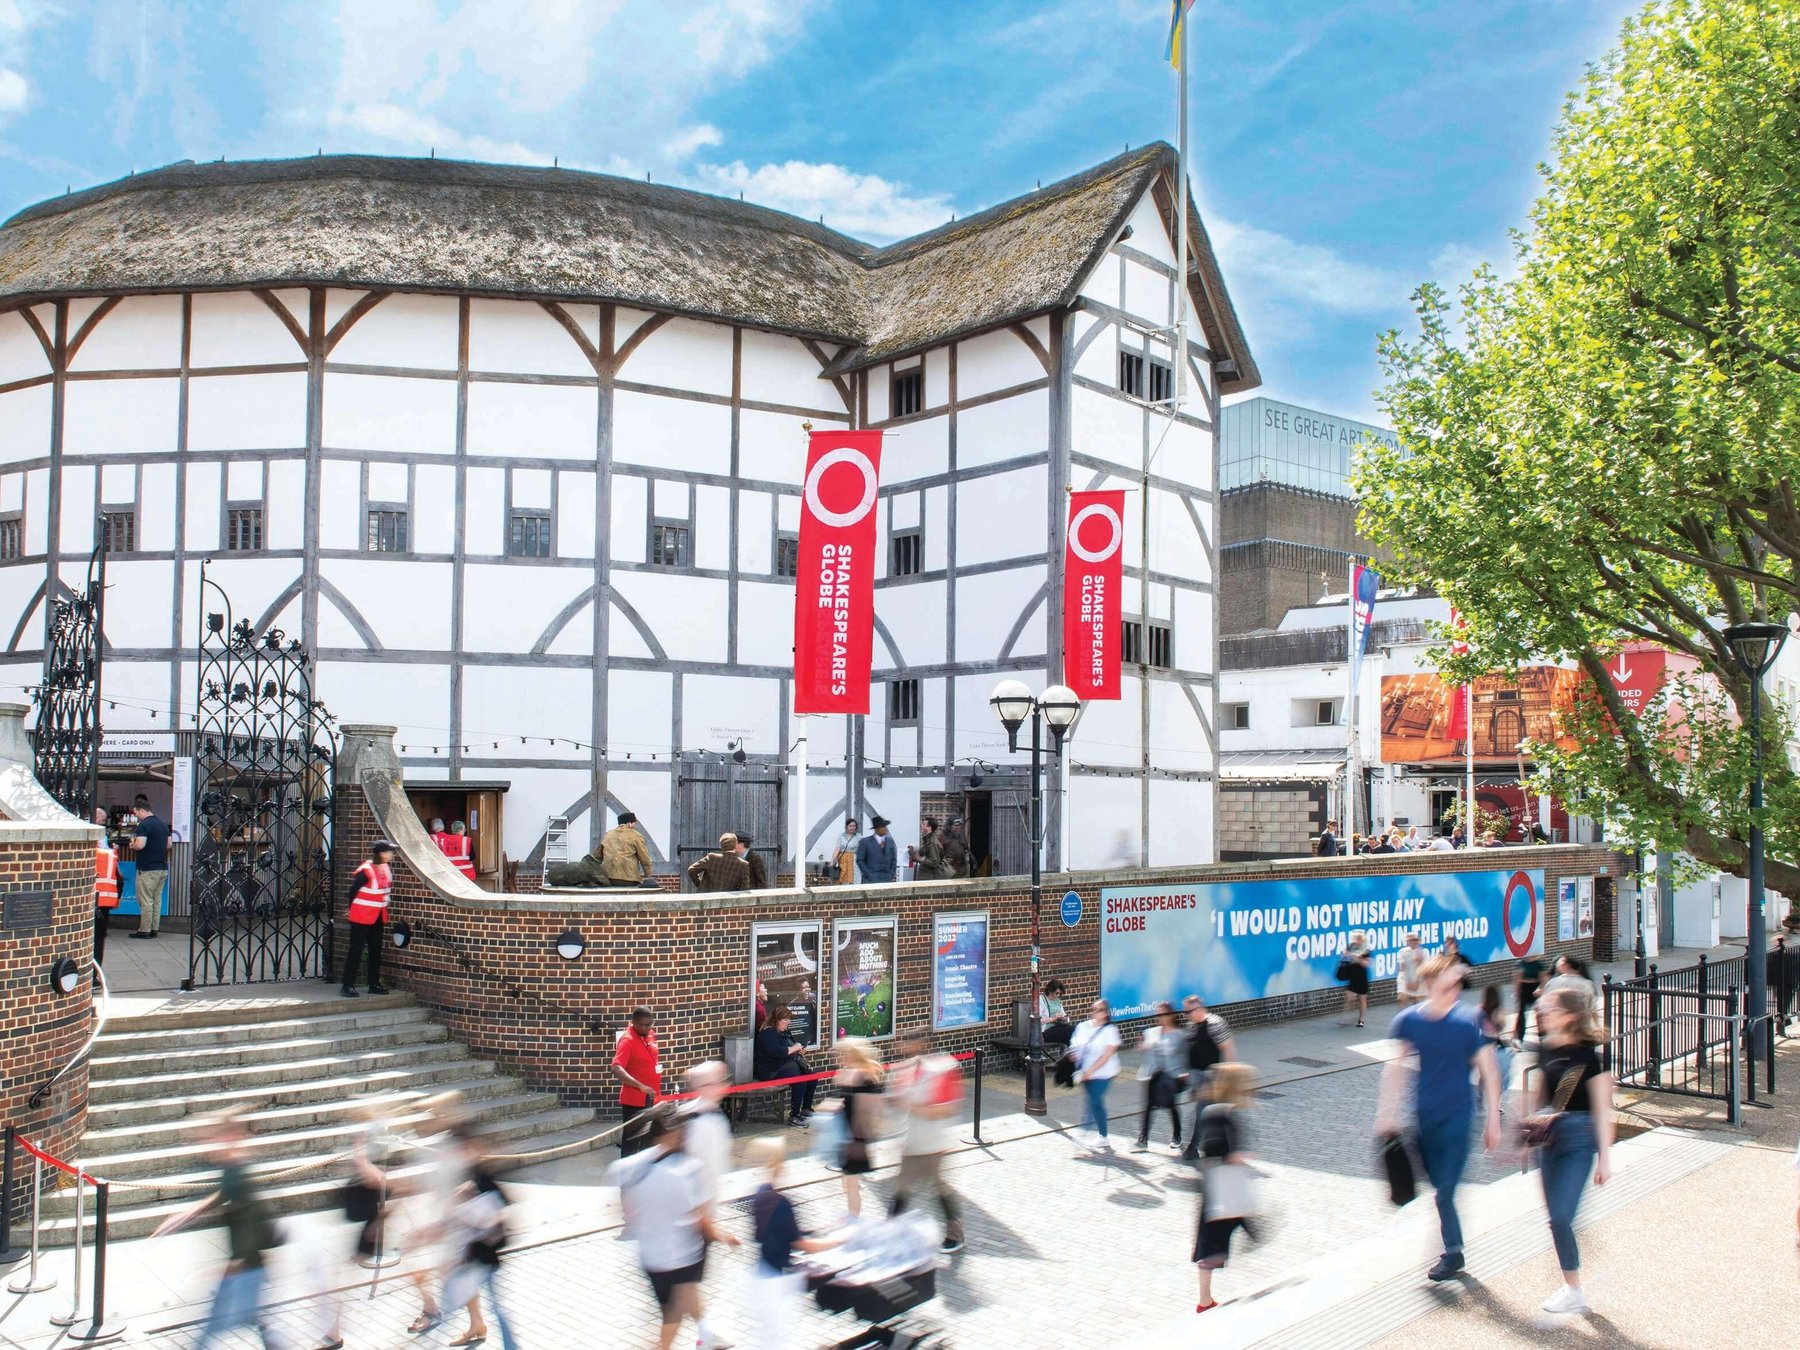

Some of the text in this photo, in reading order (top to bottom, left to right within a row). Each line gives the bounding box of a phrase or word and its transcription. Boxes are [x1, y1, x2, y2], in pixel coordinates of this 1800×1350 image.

[1265, 408, 1288, 430] SEE
[1293, 415, 1335, 441] GREAT
[1339, 427, 1363, 445] ART
[818, 543, 836, 609] GLOBE
[1081, 574, 1093, 623] GLOBE
[832, 544, 853, 696] SHAKESPEARE'S
[1092, 575, 1105, 687] SHAKESPEARE'S
[1106, 894, 1196, 914] SHAKESPEARE'S
[1230, 906, 1300, 936] WOULD
[1306, 903, 1343, 930] NOT
[1347, 900, 1389, 926] WISH
[1393, 898, 1425, 922] ANY
[938, 925, 968, 934] SUMMER
[1106, 916, 1146, 933] GLOBE
[860, 942, 879, 950] MUCH
[938, 934, 957, 943] 2022
[1286, 926, 1389, 961] COMPAON
[1392, 925, 1408, 948] IN
[1442, 916, 1489, 941] WORLD
[860, 955, 882, 963] ABOUT
[860, 961, 888, 970] NOTHING
[1375, 951, 1401, 977] BU
